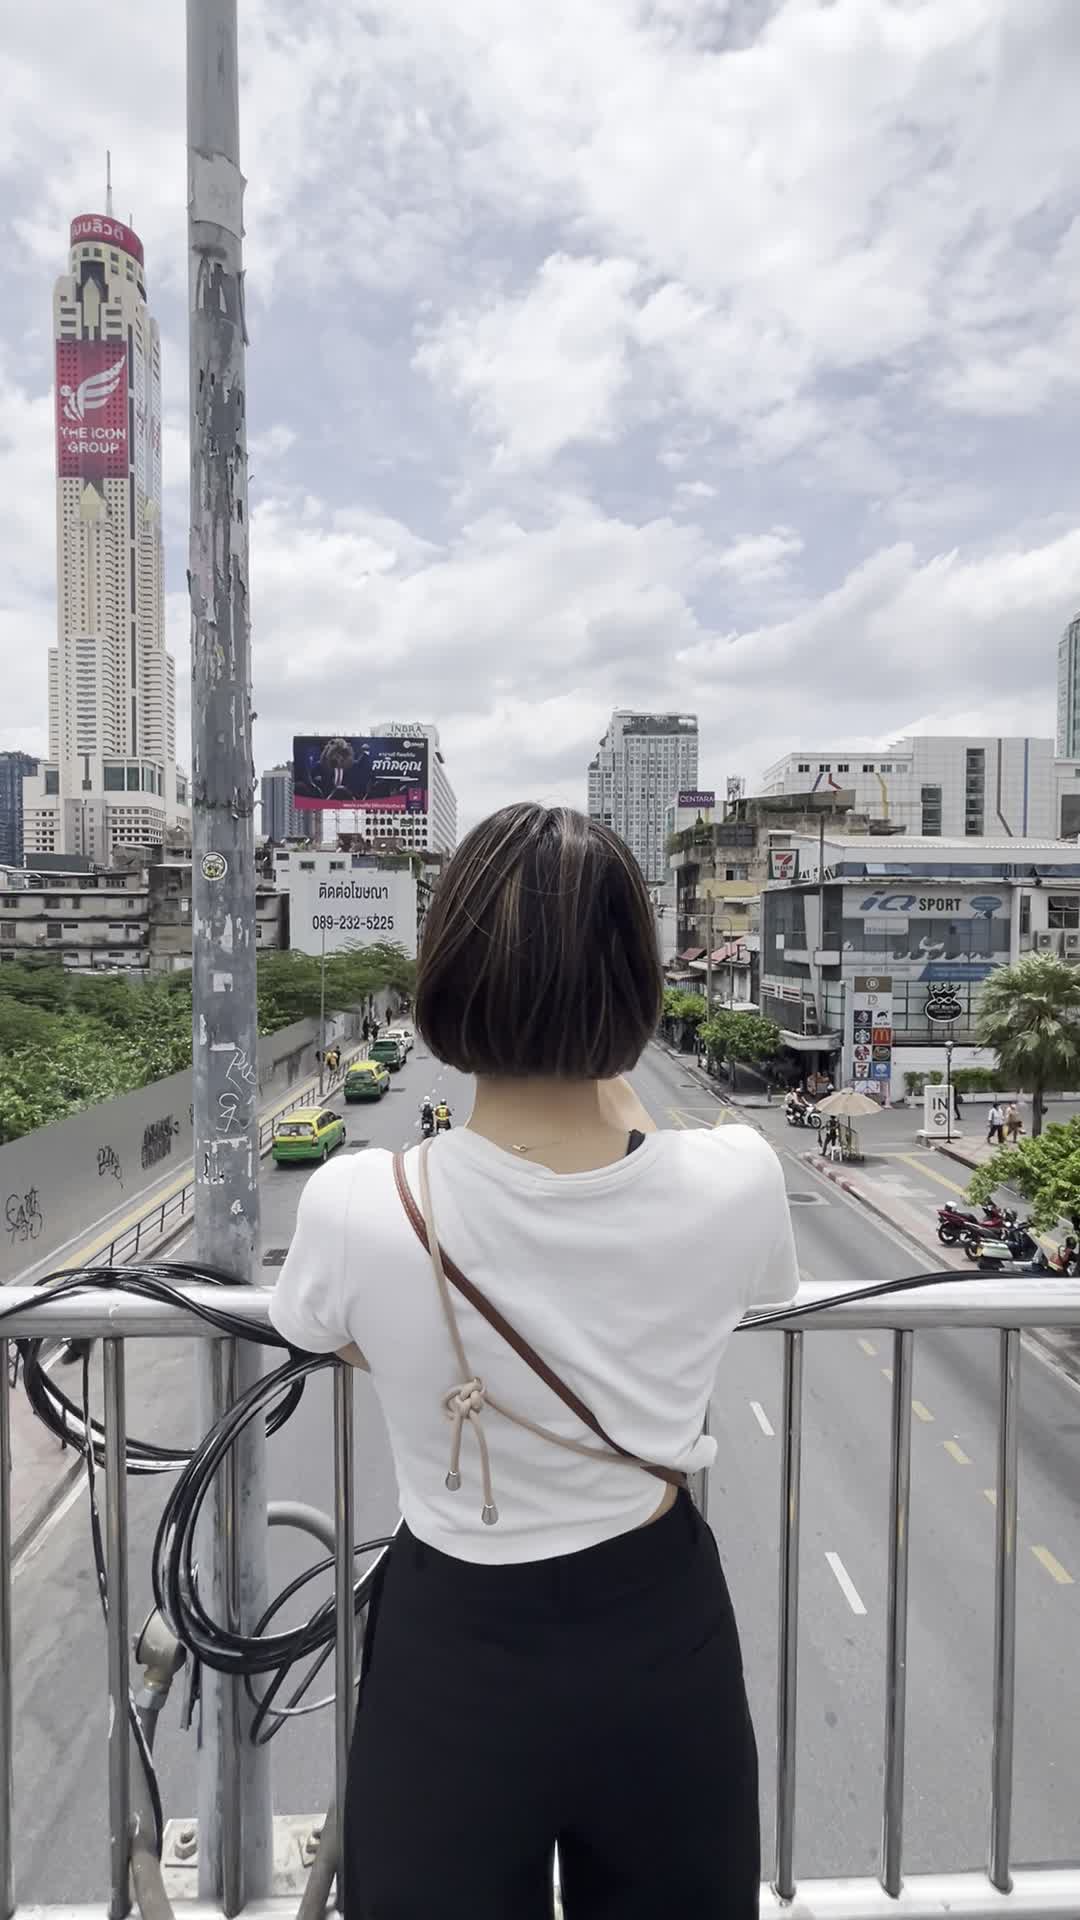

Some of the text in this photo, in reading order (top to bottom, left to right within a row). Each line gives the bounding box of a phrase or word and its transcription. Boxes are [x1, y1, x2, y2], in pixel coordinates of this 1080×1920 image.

[60, 426, 126, 439] THE ICON
[67, 441, 119, 453] GROUP
[679, 795, 714, 803] CENTARA
[318, 881, 388, 899] ติดต่อโฆษณา
[919, 898, 961, 911] SPORT
[312, 915, 394, 930] 089-232-5225
[932, 1097, 949, 1110] IN
